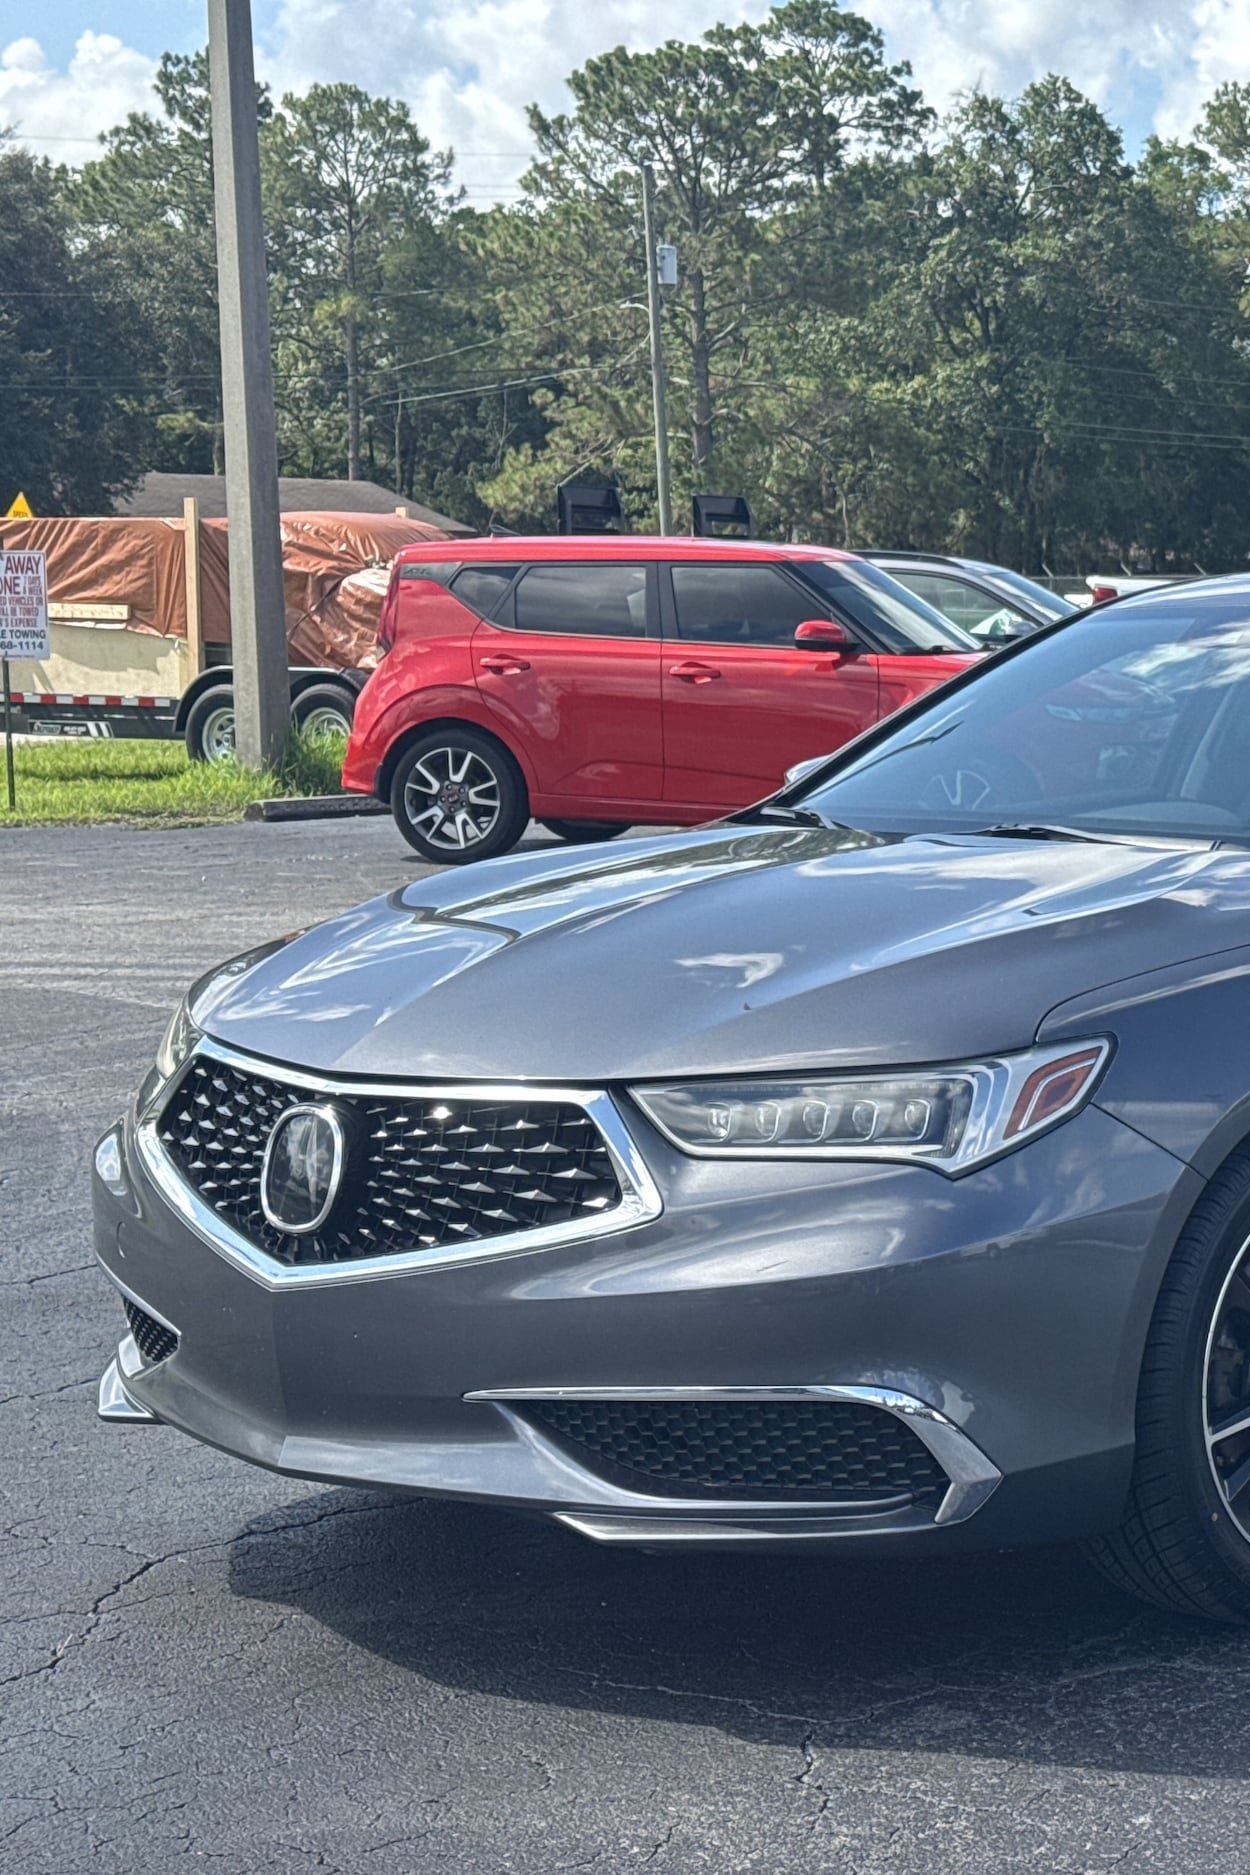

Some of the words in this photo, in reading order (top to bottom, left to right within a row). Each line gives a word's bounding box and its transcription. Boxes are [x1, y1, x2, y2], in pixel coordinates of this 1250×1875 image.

[4, 555, 41, 575] AWAY
[9, 596, 34, 606] VEHICLES
[19, 607, 39, 617] TOWED
[10, 618, 38, 628] EXPENSE
[0, 629, 7, 639] E
[9, 629, 46, 640] TOWING
